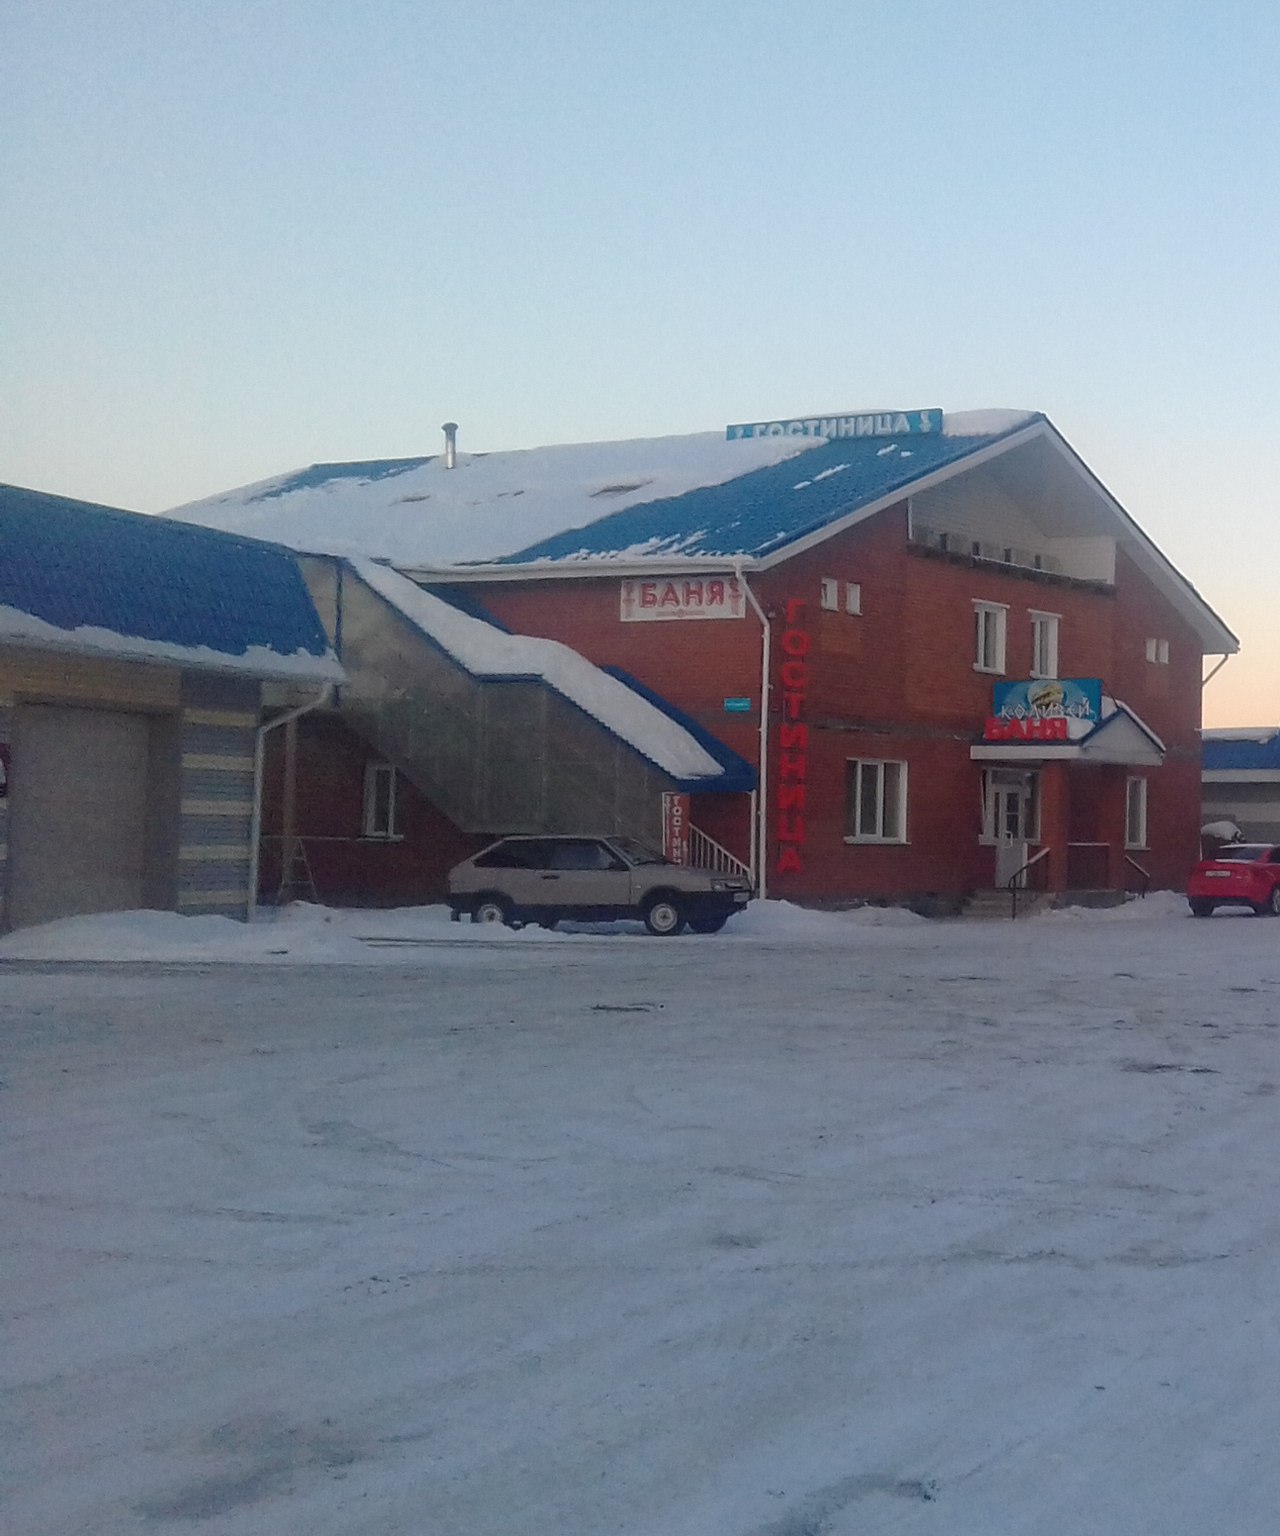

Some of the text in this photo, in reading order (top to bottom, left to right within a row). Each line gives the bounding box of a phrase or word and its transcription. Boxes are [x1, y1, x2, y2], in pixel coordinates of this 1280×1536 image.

[756, 412, 911, 440] ГОСТИНИЦА
[639, 581, 725, 609] БАНЯ
[778, 599, 810, 874] ГОСТИНИЦА
[985, 716, 1067, 740] БАНЯ
